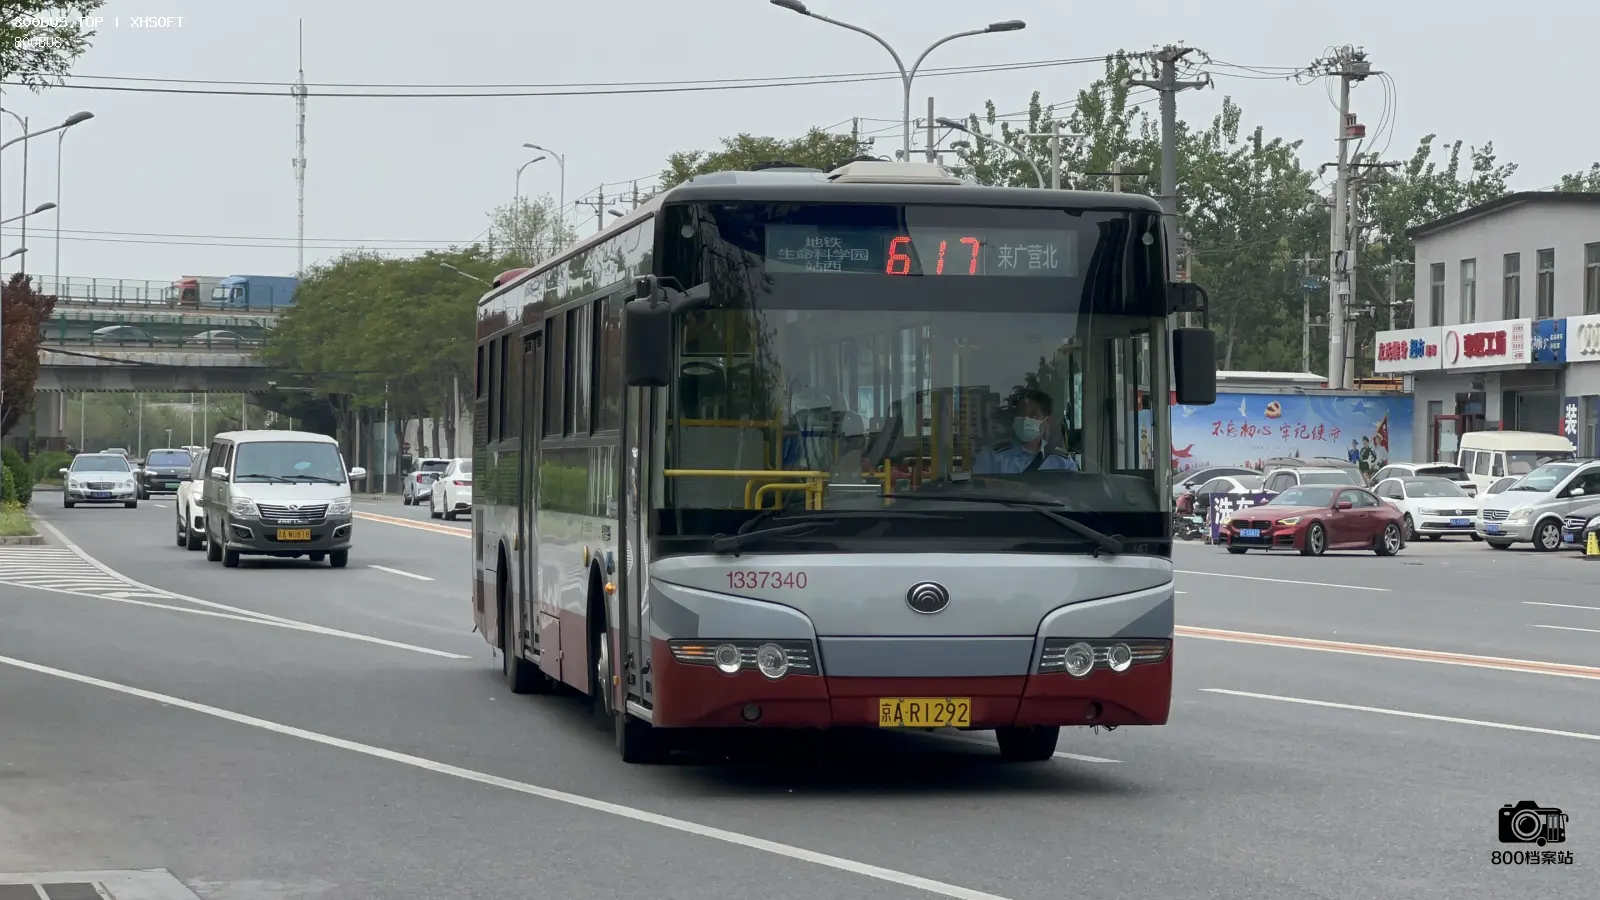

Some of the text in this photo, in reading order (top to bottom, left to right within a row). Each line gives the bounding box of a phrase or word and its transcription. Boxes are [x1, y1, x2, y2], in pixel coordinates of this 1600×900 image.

[804, 236, 842, 248] 地铁
[777, 248, 869, 261] 生命科学园
[886, 236, 980, 276] 617
[998, 244, 1058, 270] 来广营北
[804, 260, 842, 272] 站西
[1212, 420, 1342, 443] 不忘初心 牢记使命
[726, 571, 807, 589] 1337340
